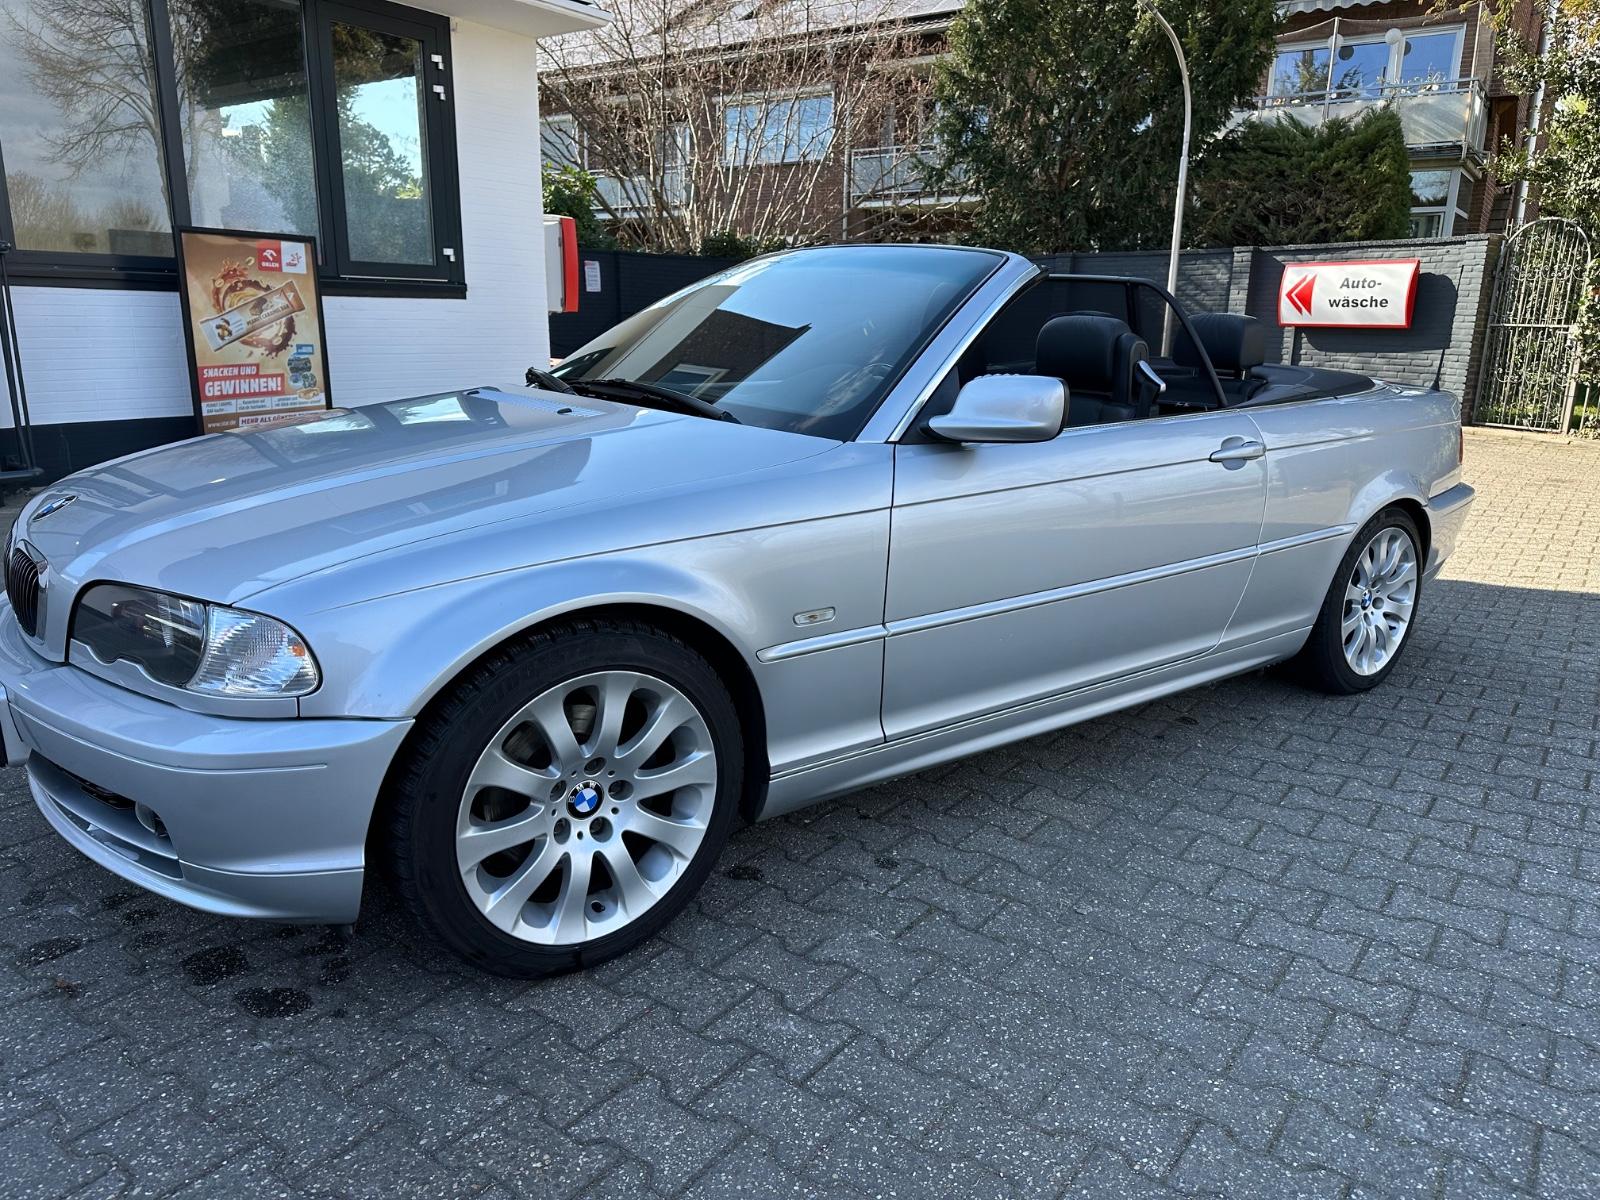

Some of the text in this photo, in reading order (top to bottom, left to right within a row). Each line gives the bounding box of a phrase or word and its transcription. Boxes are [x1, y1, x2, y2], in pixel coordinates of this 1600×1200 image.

[1339, 277, 1382, 289] Auto-
[1328, 295, 1389, 308] wäsche
[203, 365, 257, 378] SNACKEN UND
[205, 376, 282, 397] GEWINNEN!
[241, 417, 259, 425] MEHR
